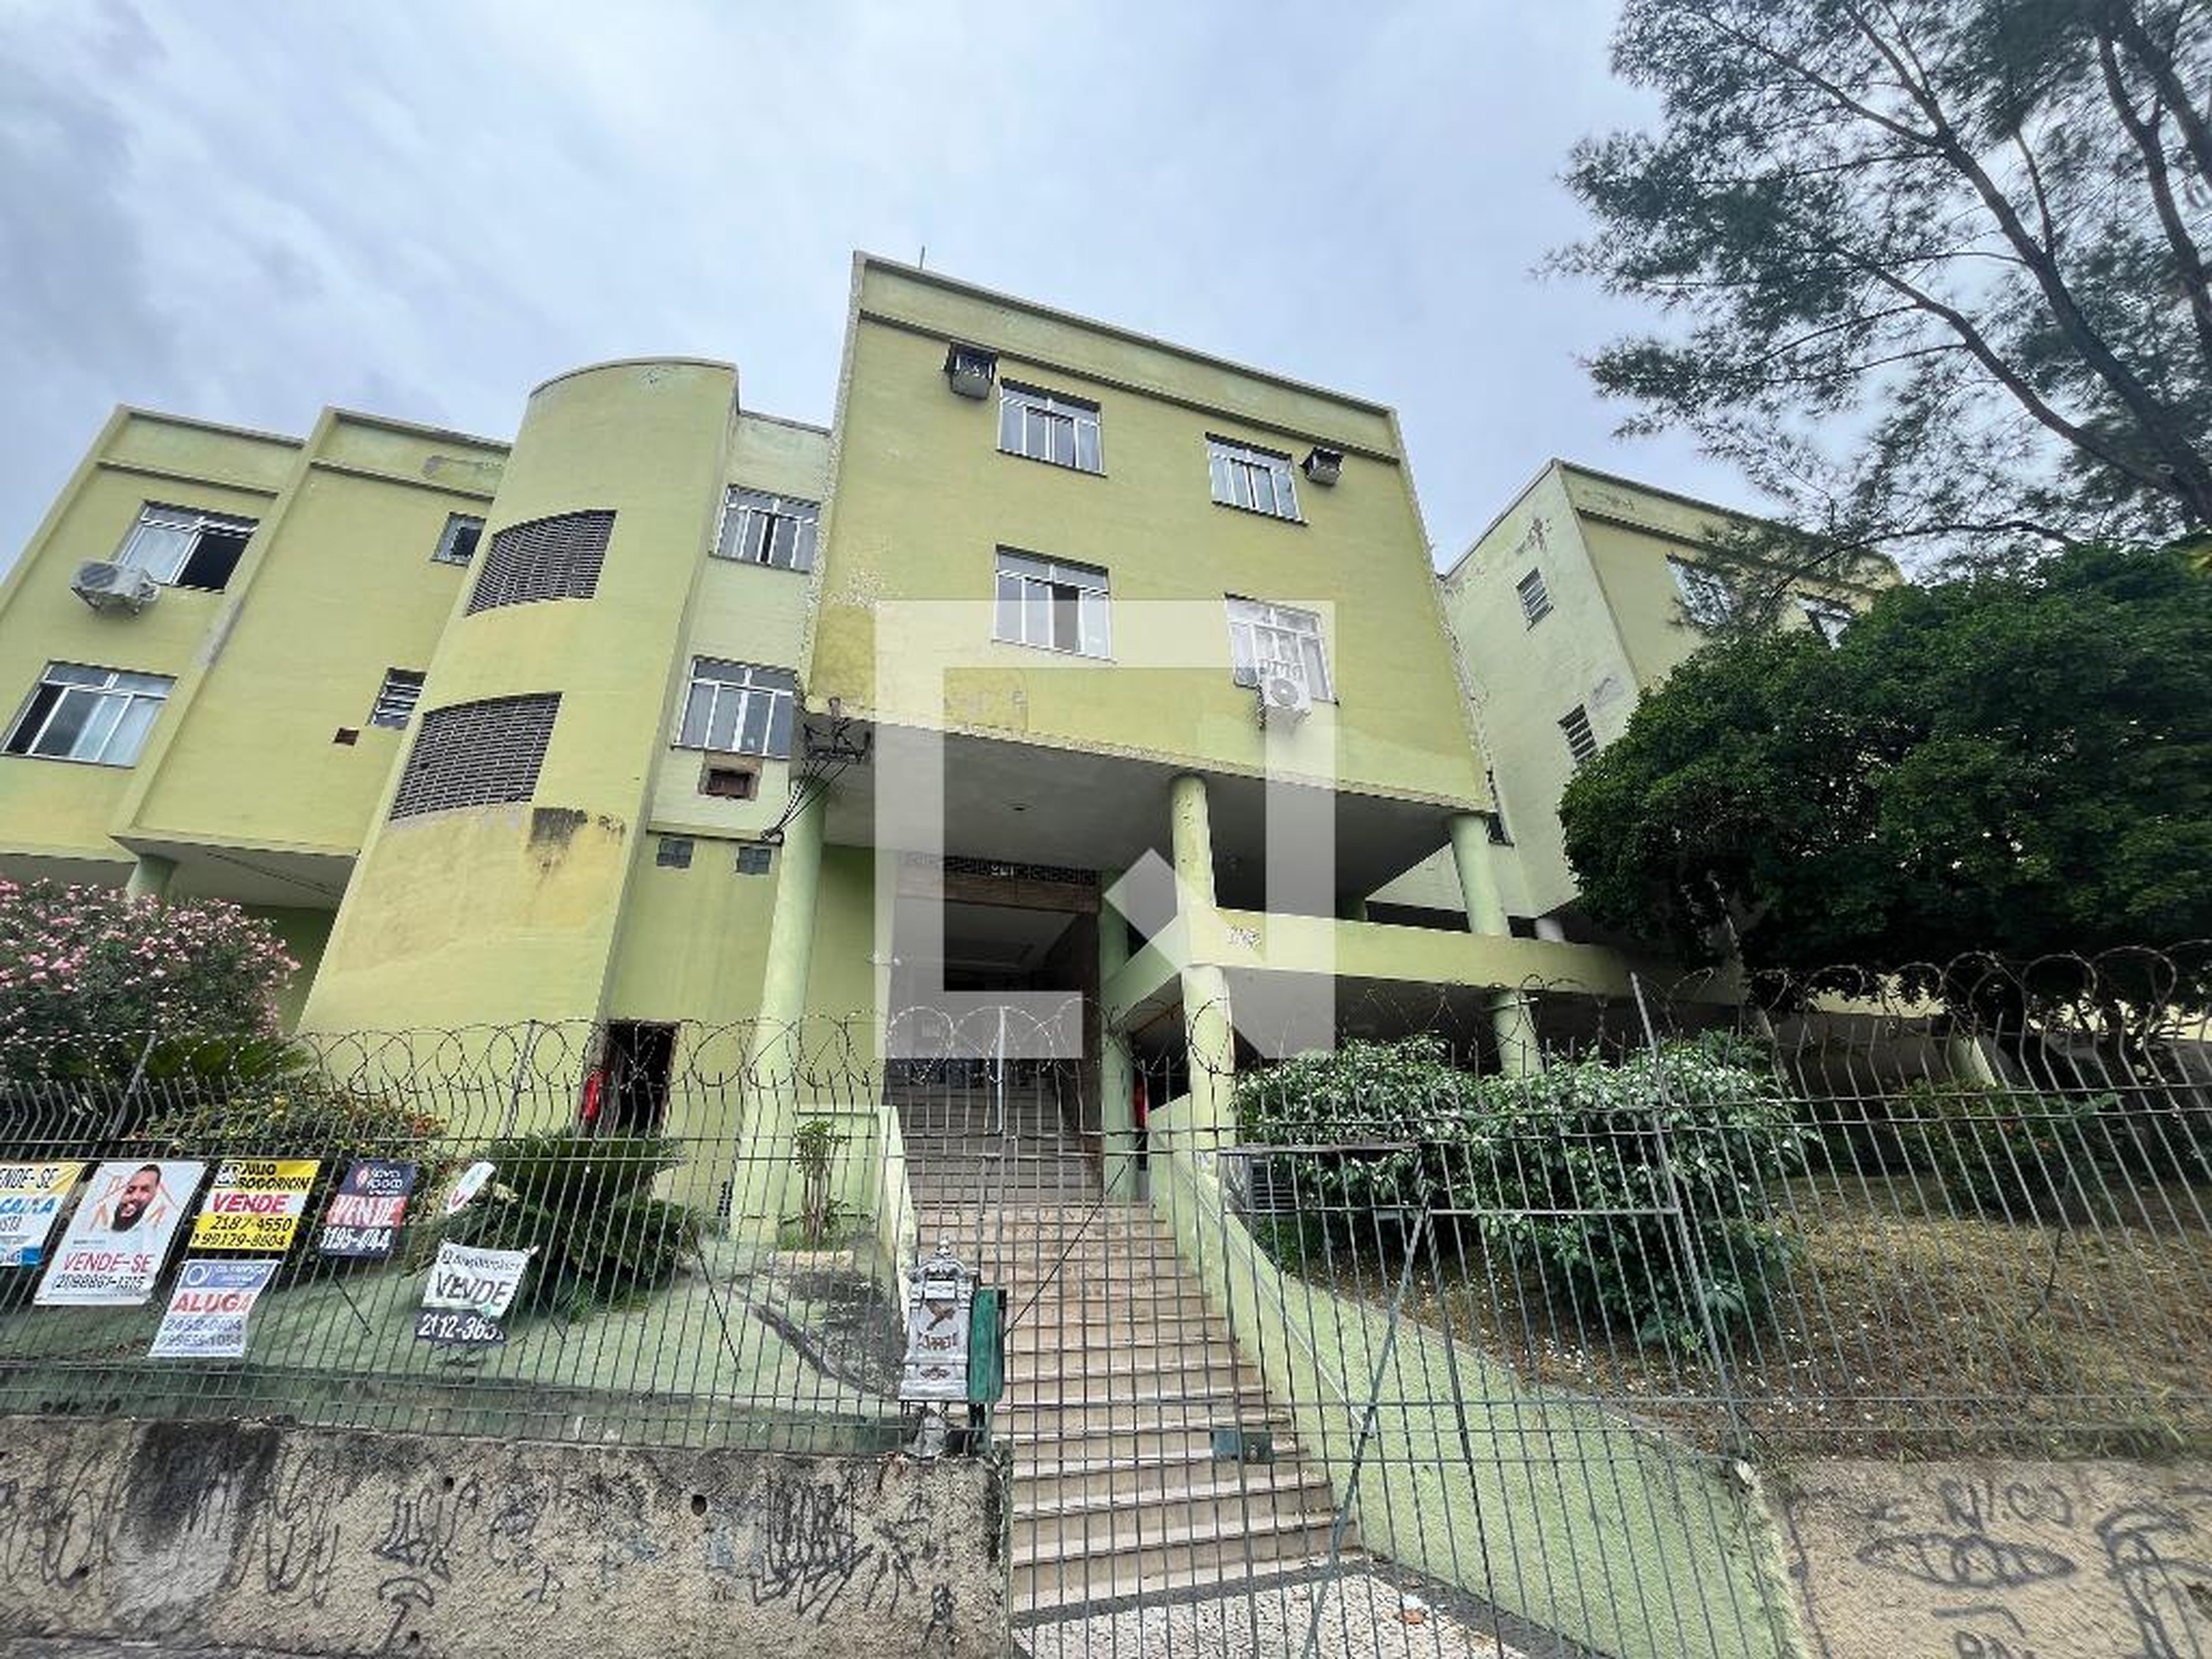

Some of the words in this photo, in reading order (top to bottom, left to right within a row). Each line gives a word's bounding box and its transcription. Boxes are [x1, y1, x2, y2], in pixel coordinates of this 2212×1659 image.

[212, 1193, 290, 1213] VENDE
[64, 1252, 155, 1272] VENDE-SE
[436, 1271, 512, 1306] VENDE
[172, 1294, 253, 1312] ALUGA
